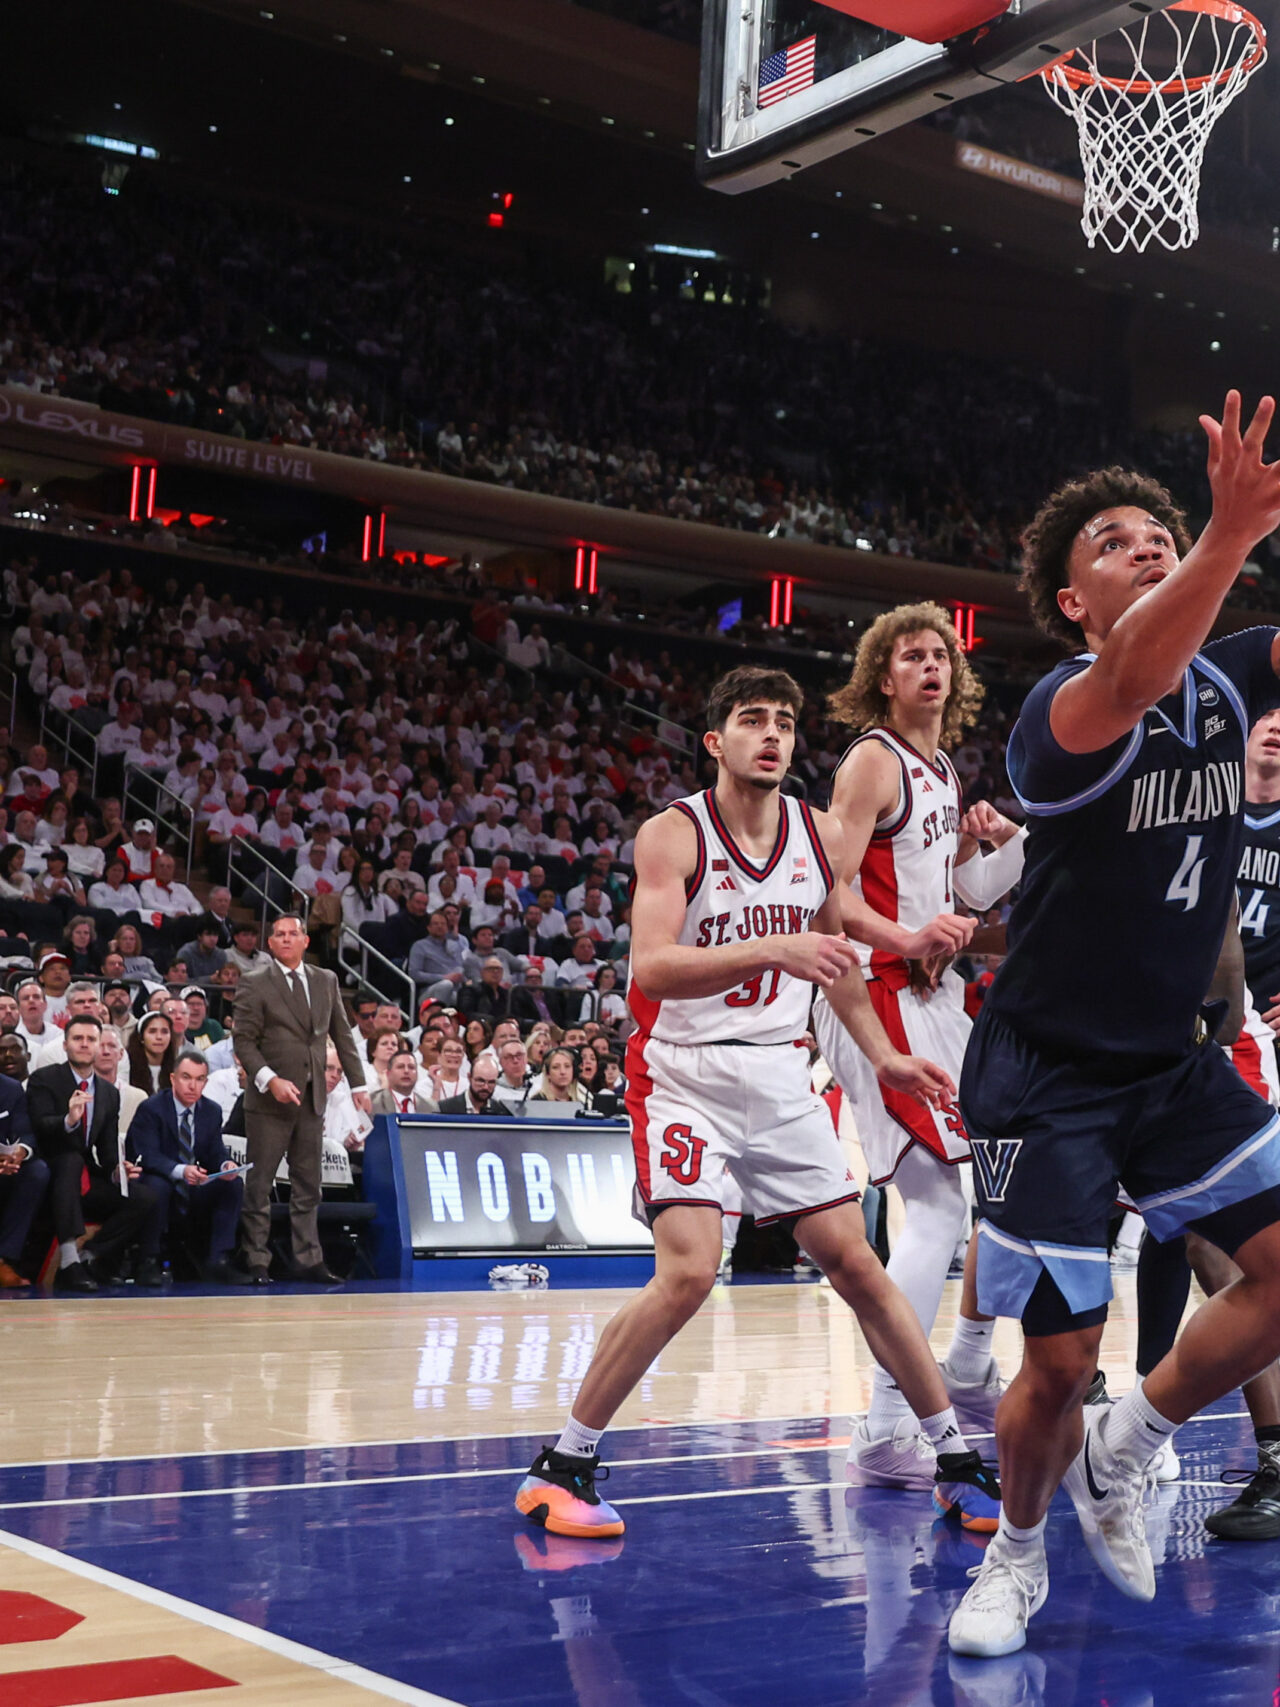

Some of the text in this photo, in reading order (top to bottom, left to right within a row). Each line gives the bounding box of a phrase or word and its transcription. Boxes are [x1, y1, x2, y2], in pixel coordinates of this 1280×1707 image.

[988, 157, 1062, 194] HYUNDAI
[16, 404, 145, 448] LEXUS
[184, 440, 316, 482] SUITE LEVEL
[1198, 687, 1216, 702] GHR
[1164, 834, 1209, 912] 4
[696, 911, 732, 947] ST.
[1240, 888, 1271, 938] 4
[724, 967, 782, 1008] 31
[970, 1139, 1023, 1202] V
